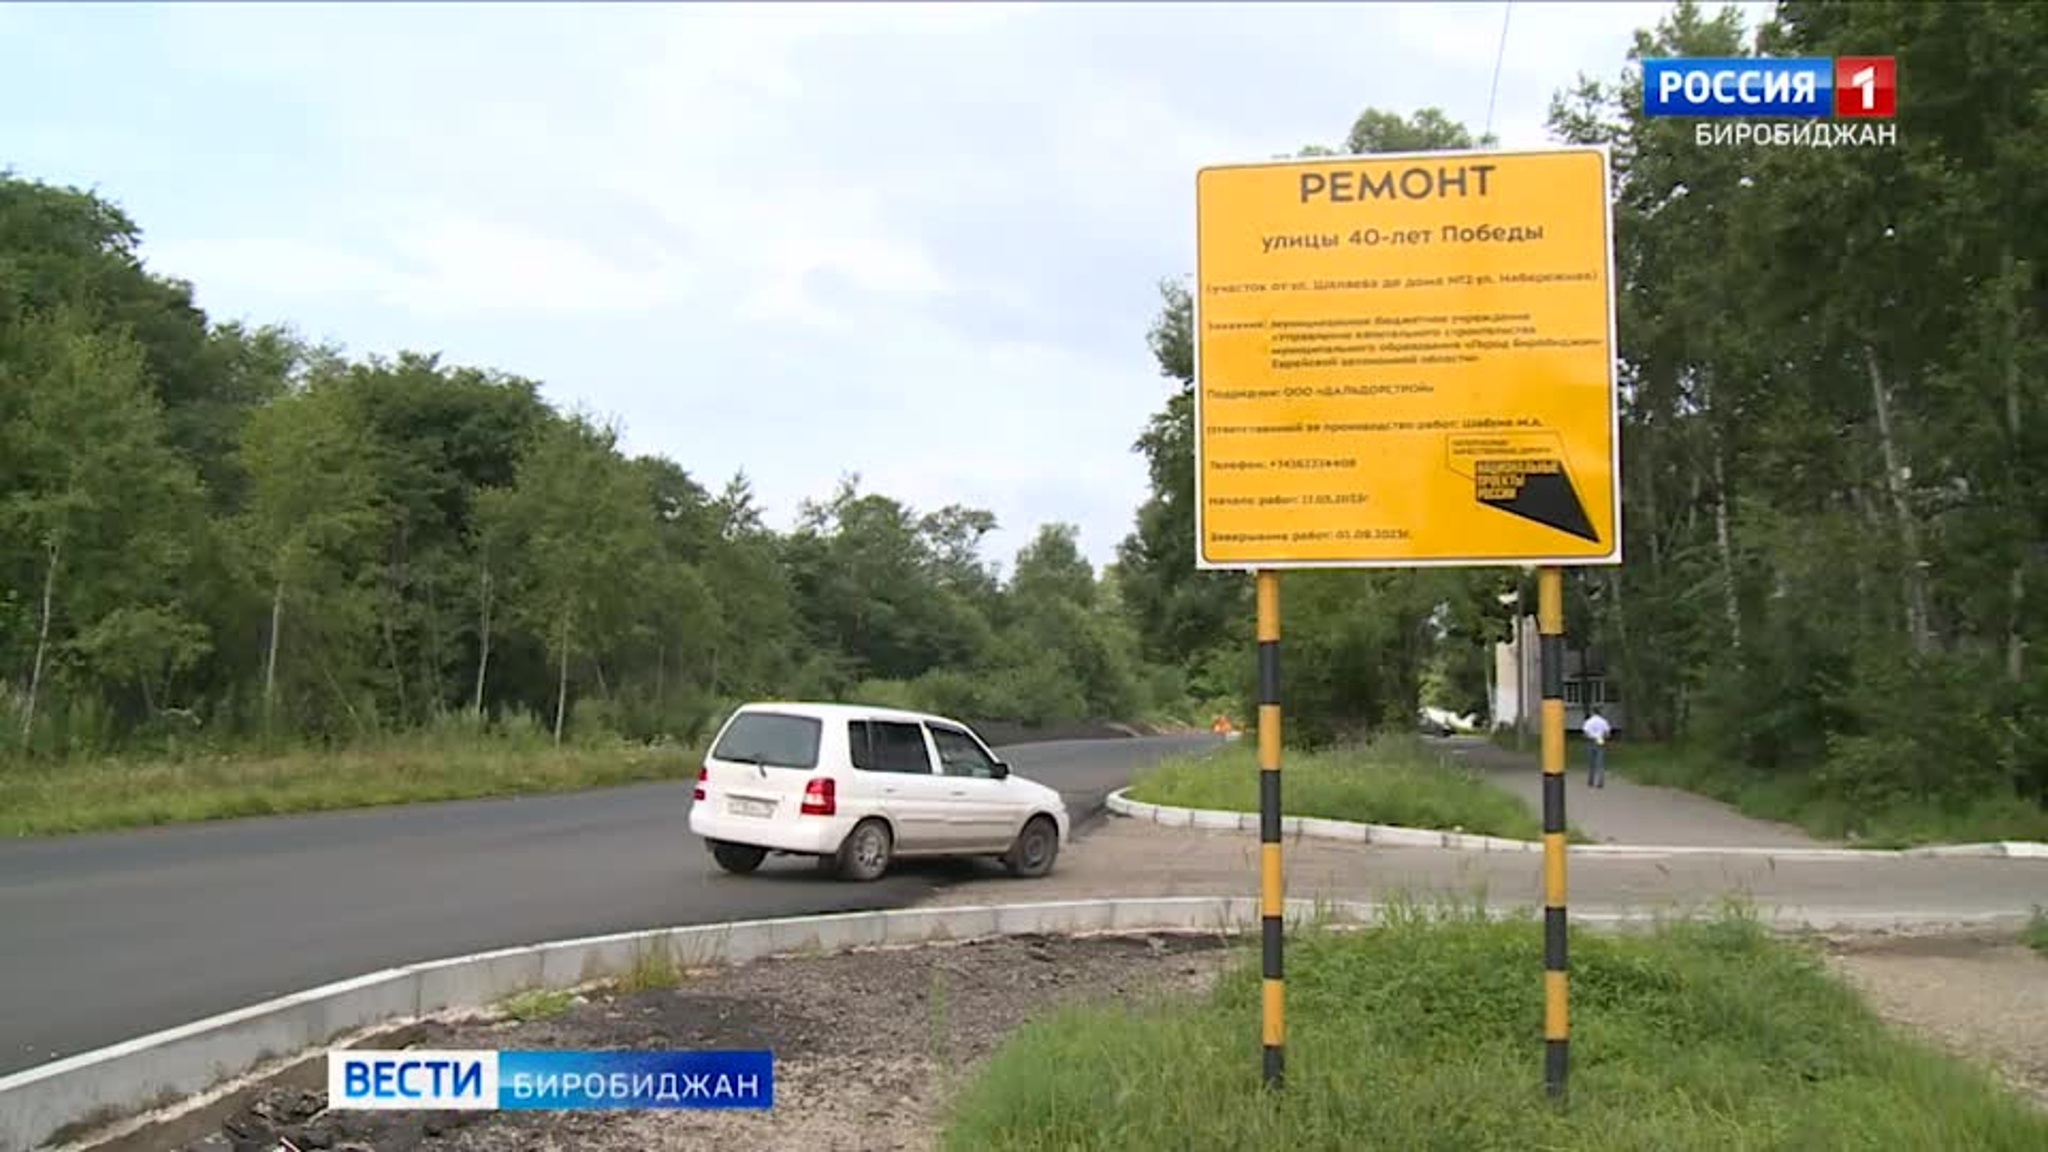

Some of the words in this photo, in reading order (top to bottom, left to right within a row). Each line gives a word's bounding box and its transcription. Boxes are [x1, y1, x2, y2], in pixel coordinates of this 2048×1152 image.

[1300, 165, 1496, 203] РЕМОНТ
[1261, 233, 1339, 253] улицы
[1348, 228, 1431, 247] 40-лет
[1441, 225, 1544, 243] Победы
[1283, 386, 1313, 397] ООО
